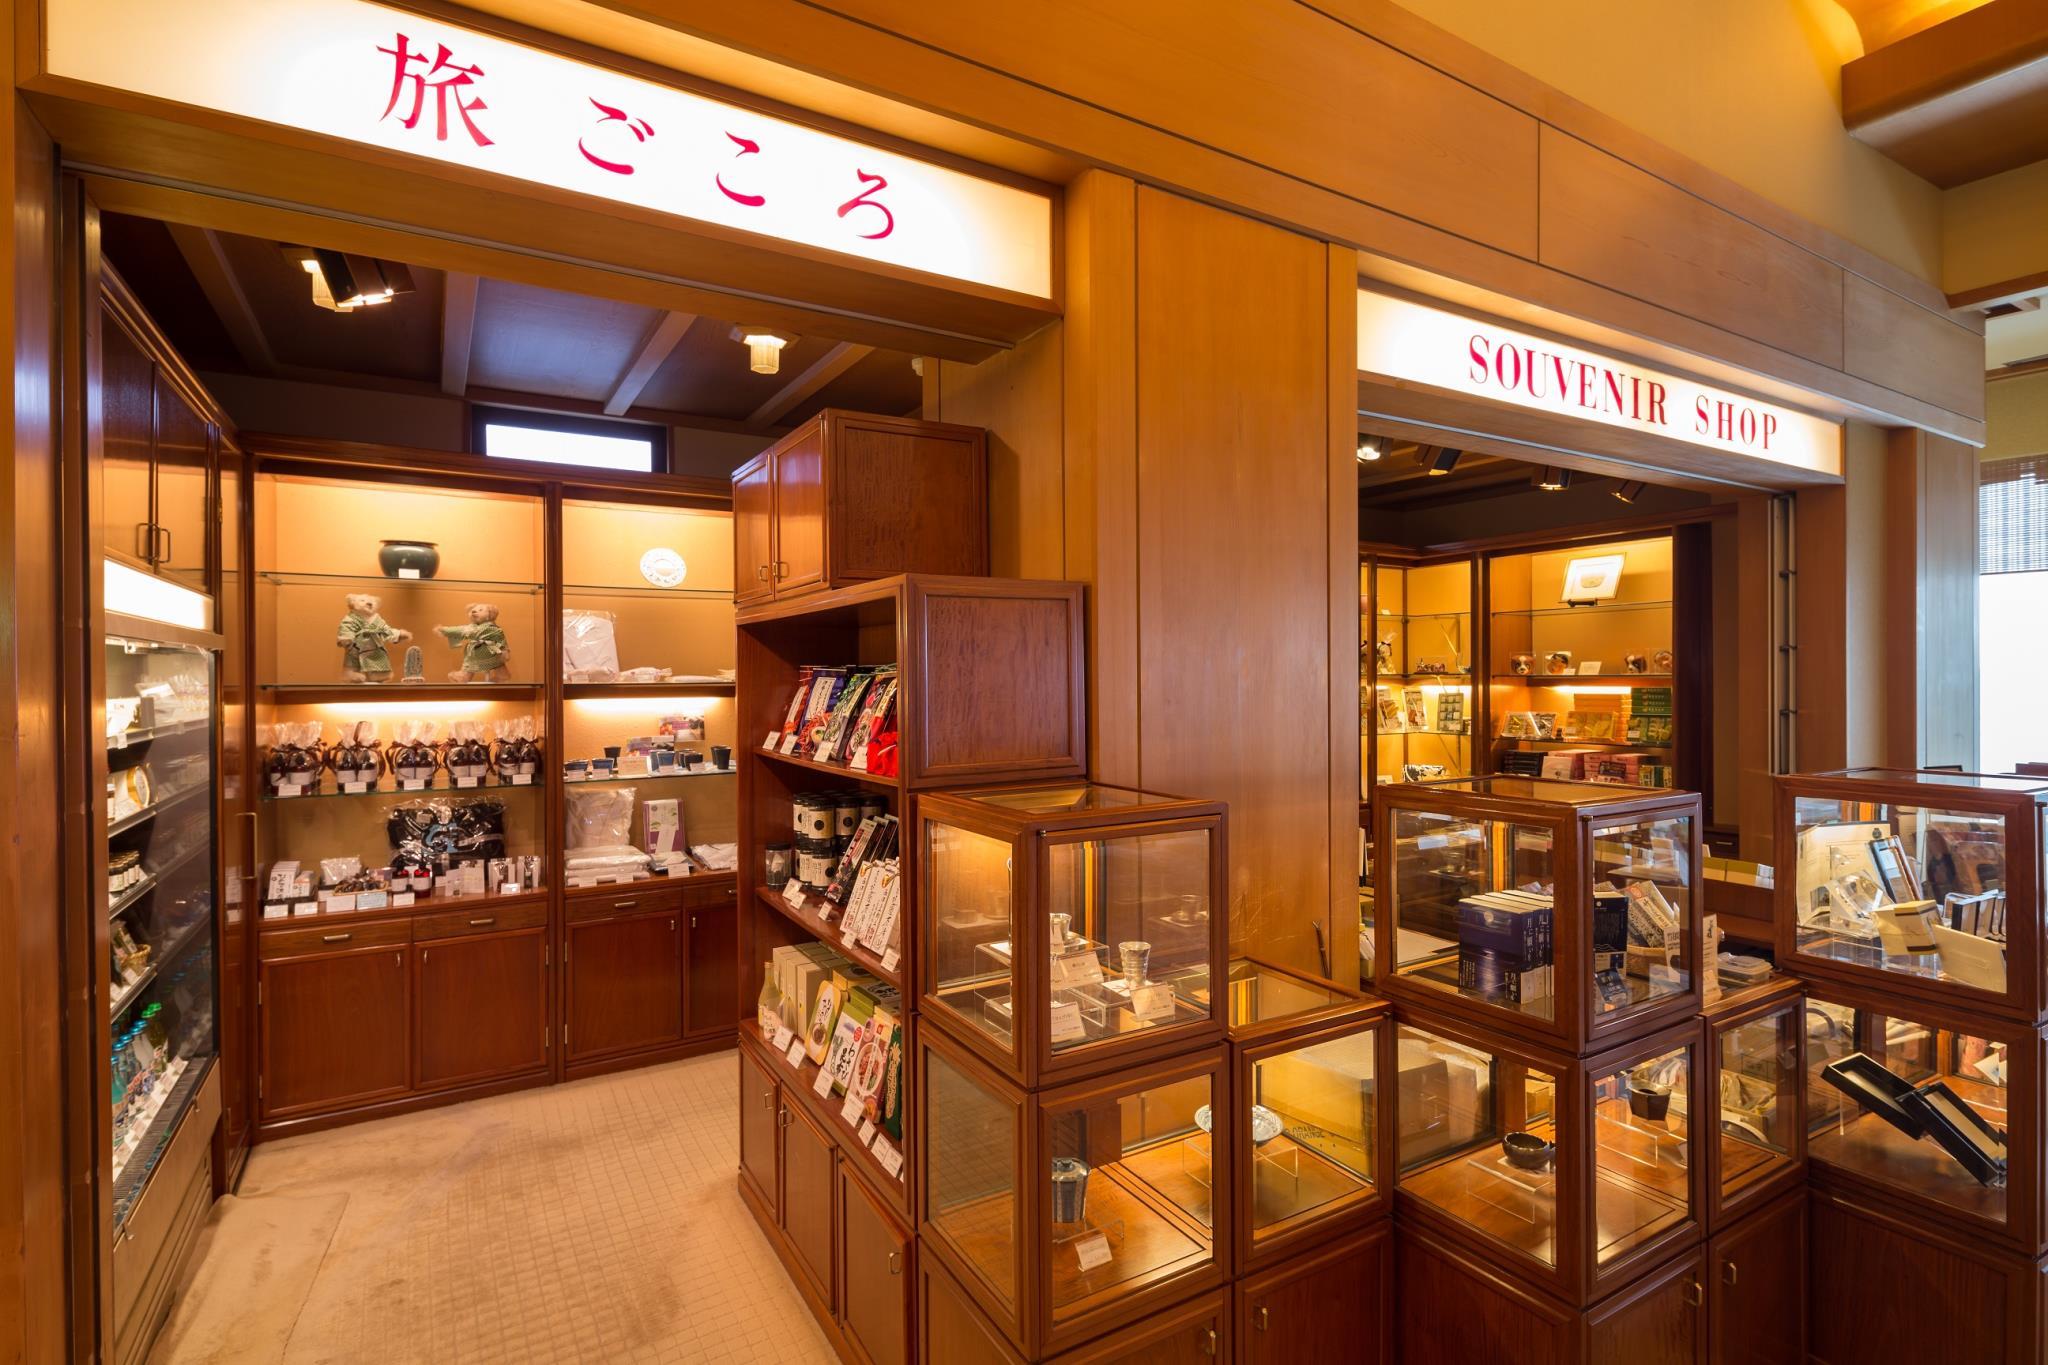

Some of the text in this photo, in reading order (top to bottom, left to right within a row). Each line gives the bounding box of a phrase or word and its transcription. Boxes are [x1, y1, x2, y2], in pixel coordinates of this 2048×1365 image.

[376, 32, 896, 241] 旅ごころ
[1468, 334, 1778, 451] SOUVENIR SHOP
